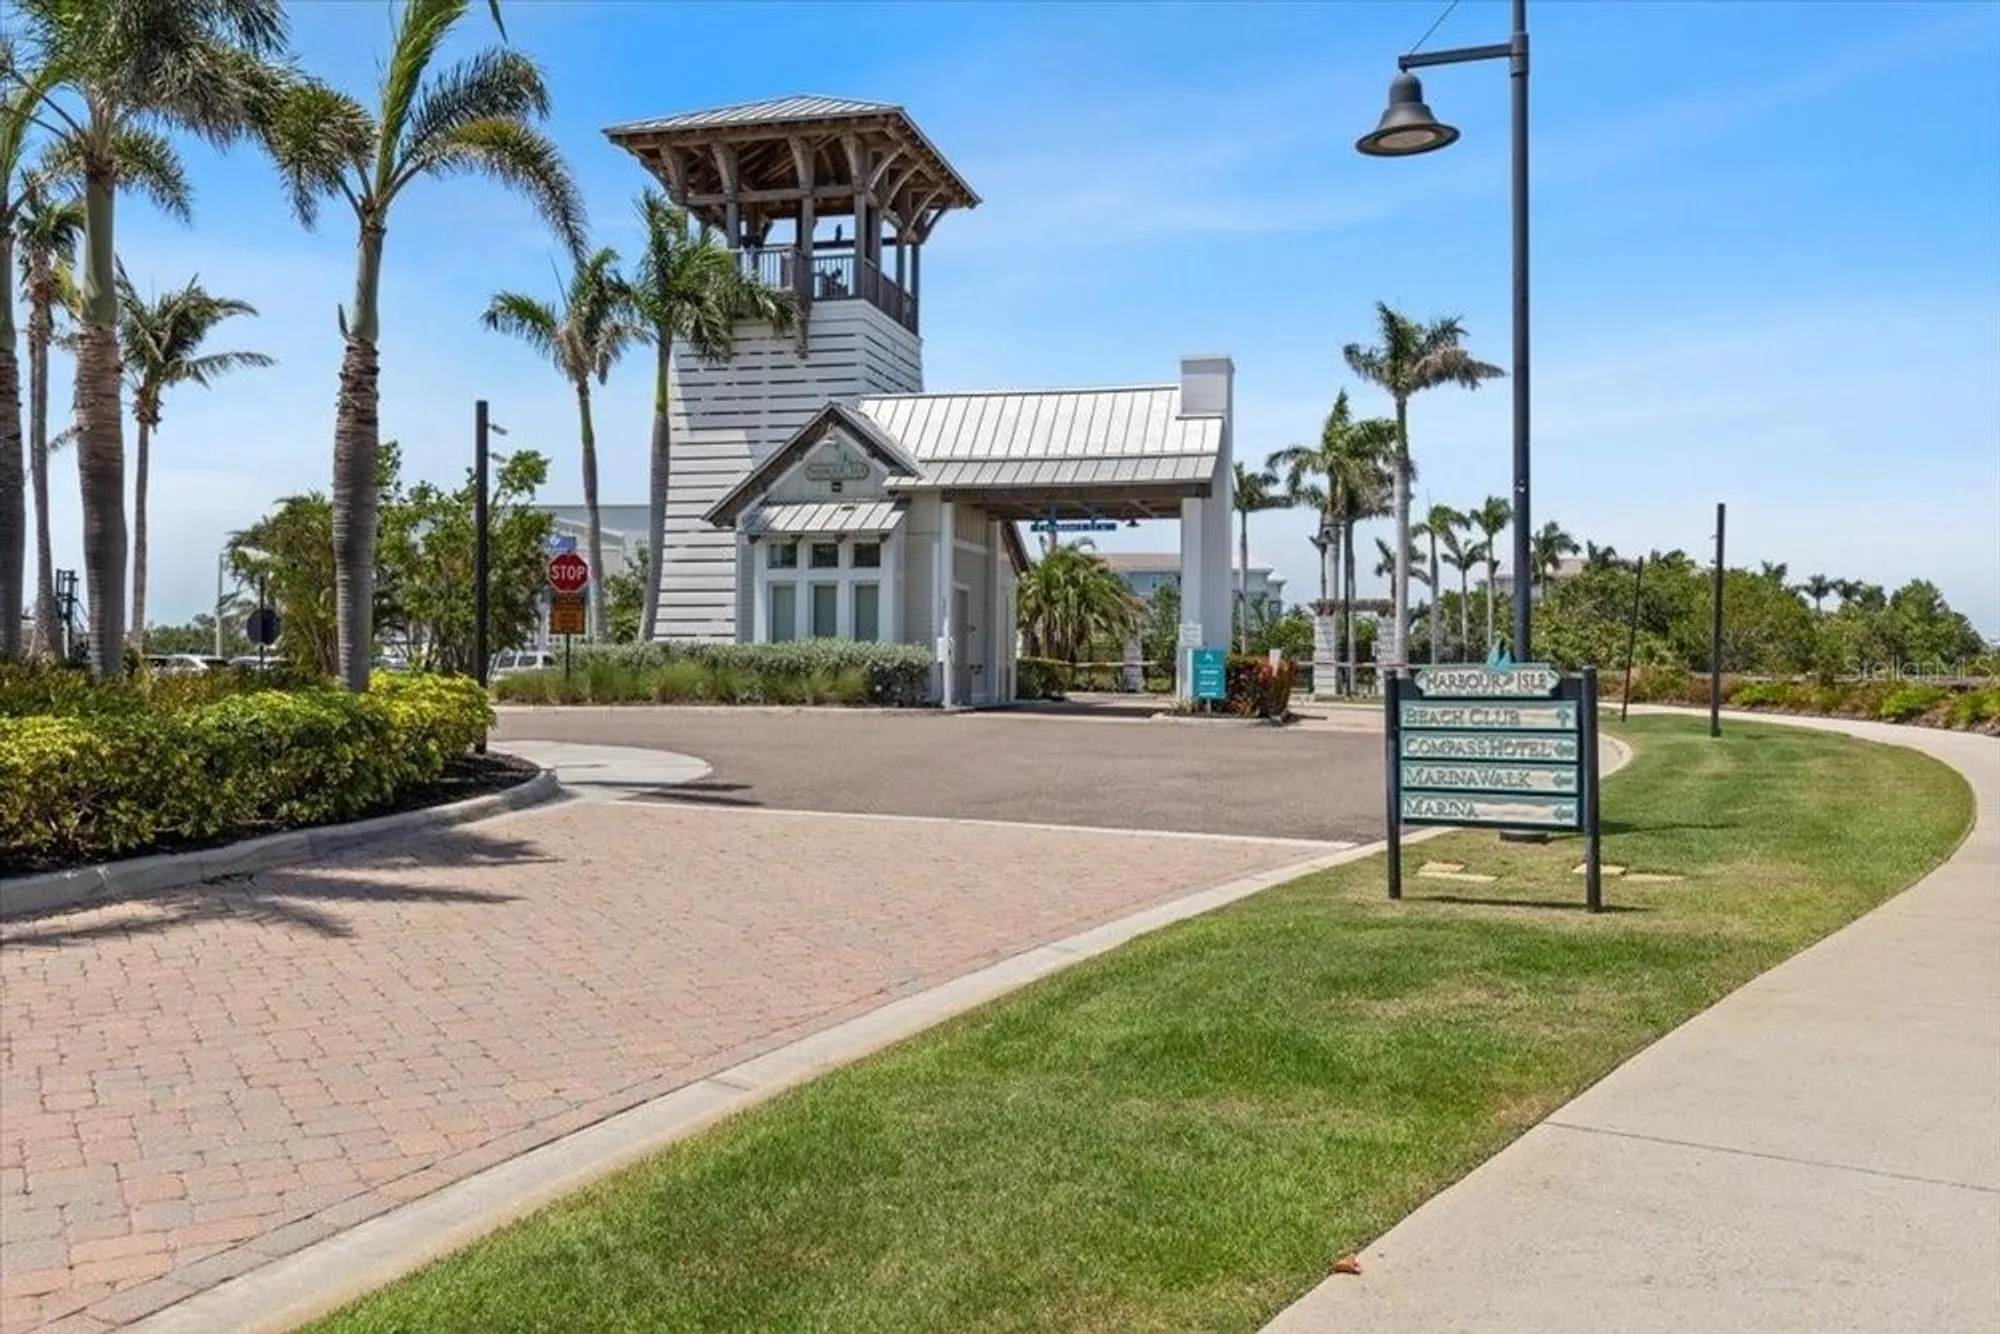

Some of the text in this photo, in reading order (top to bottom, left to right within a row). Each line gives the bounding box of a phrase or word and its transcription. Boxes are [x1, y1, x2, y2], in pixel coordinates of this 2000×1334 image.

[552, 564, 586, 580] STOP
[1426, 670, 1547, 690] HARBOUR ISLE
[1405, 708, 1521, 726] BEACH CLUB
[1405, 737, 1553, 758] COMPASS HOTEL
[1404, 798, 1479, 818] MARINA
